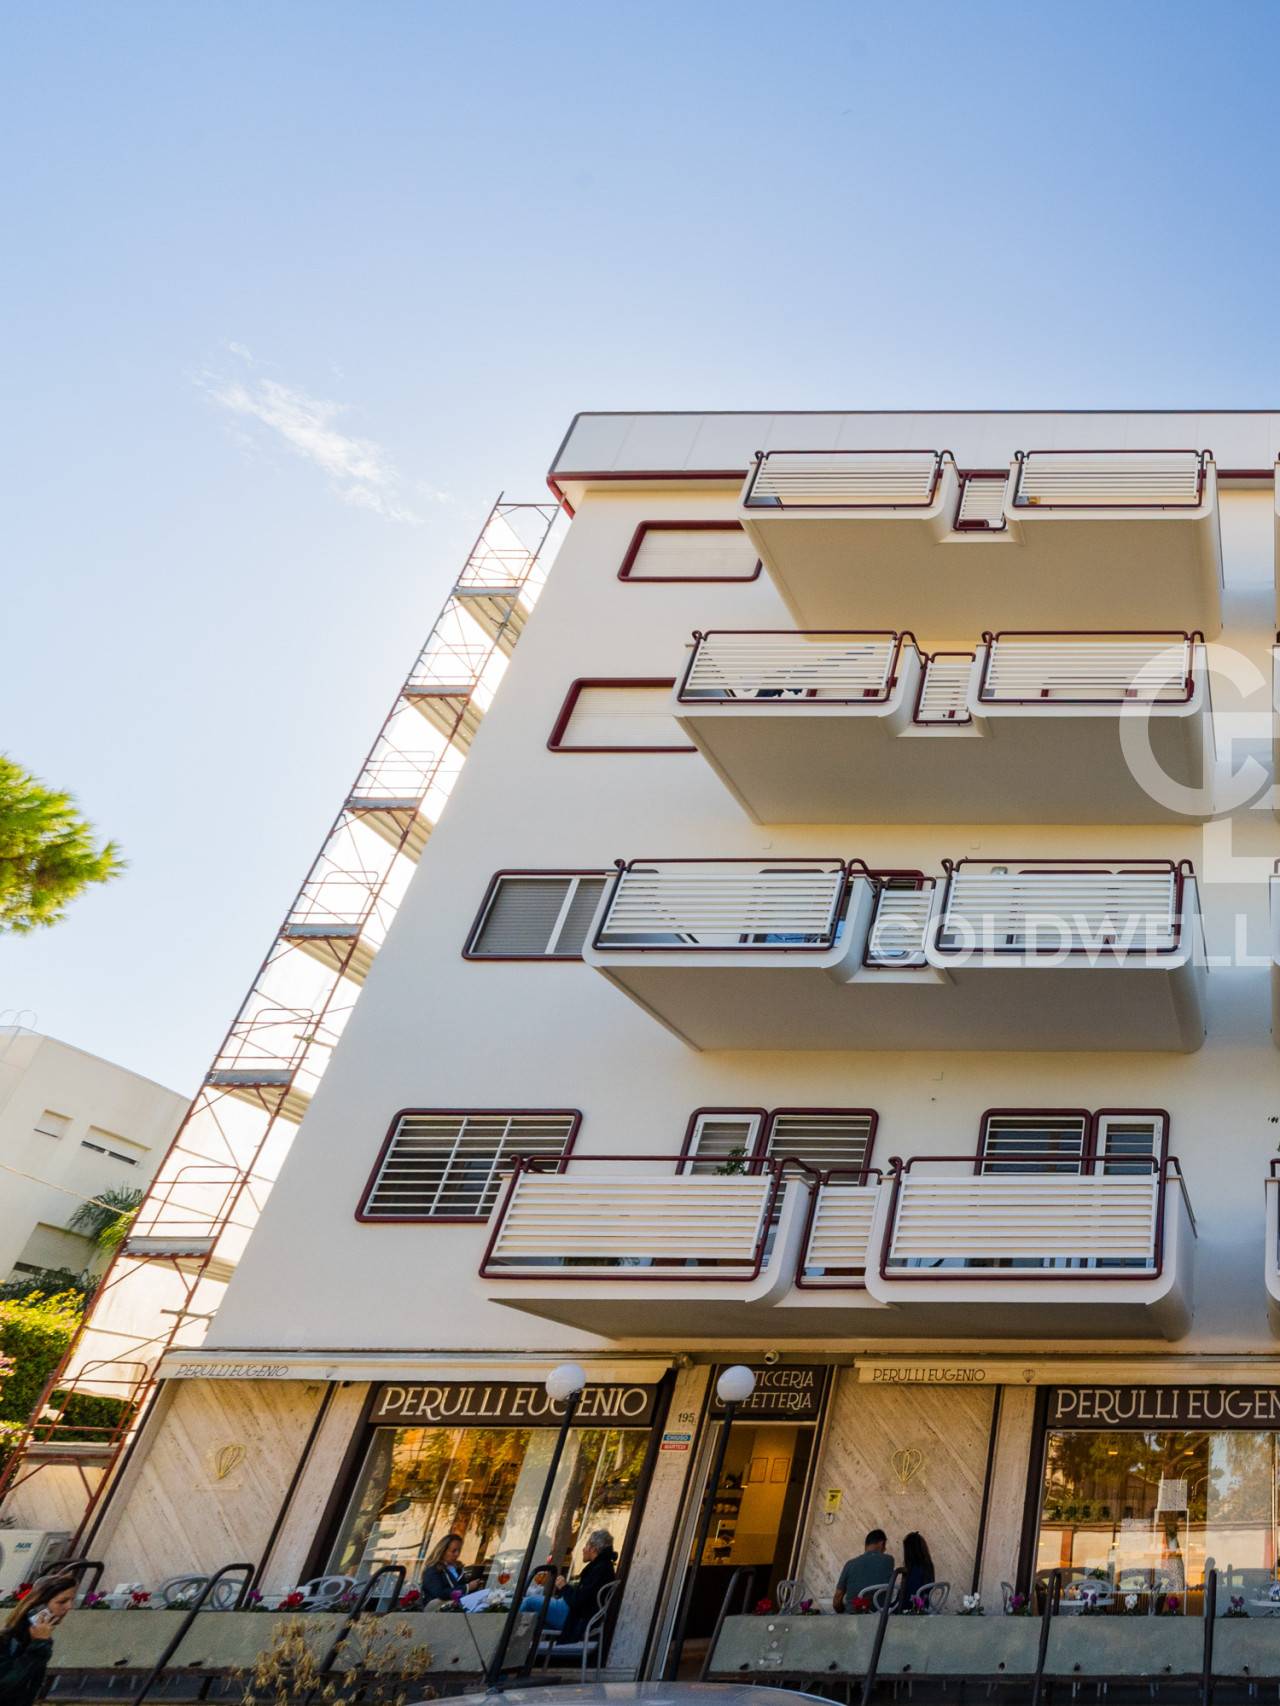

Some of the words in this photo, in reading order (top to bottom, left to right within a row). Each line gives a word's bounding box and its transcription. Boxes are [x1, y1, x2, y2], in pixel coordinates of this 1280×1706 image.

[175, 1364, 230, 1378] PERULLI
[229, 1364, 289, 1378] EUGENIO
[752, 1371, 814, 1389] TICCERIA
[872, 1368, 926, 1383] PERULLI
[927, 1368, 986, 1382] EUGENIO
[378, 1386, 507, 1421] PERULLI
[1055, 1389, 1178, 1424] PERULLI
